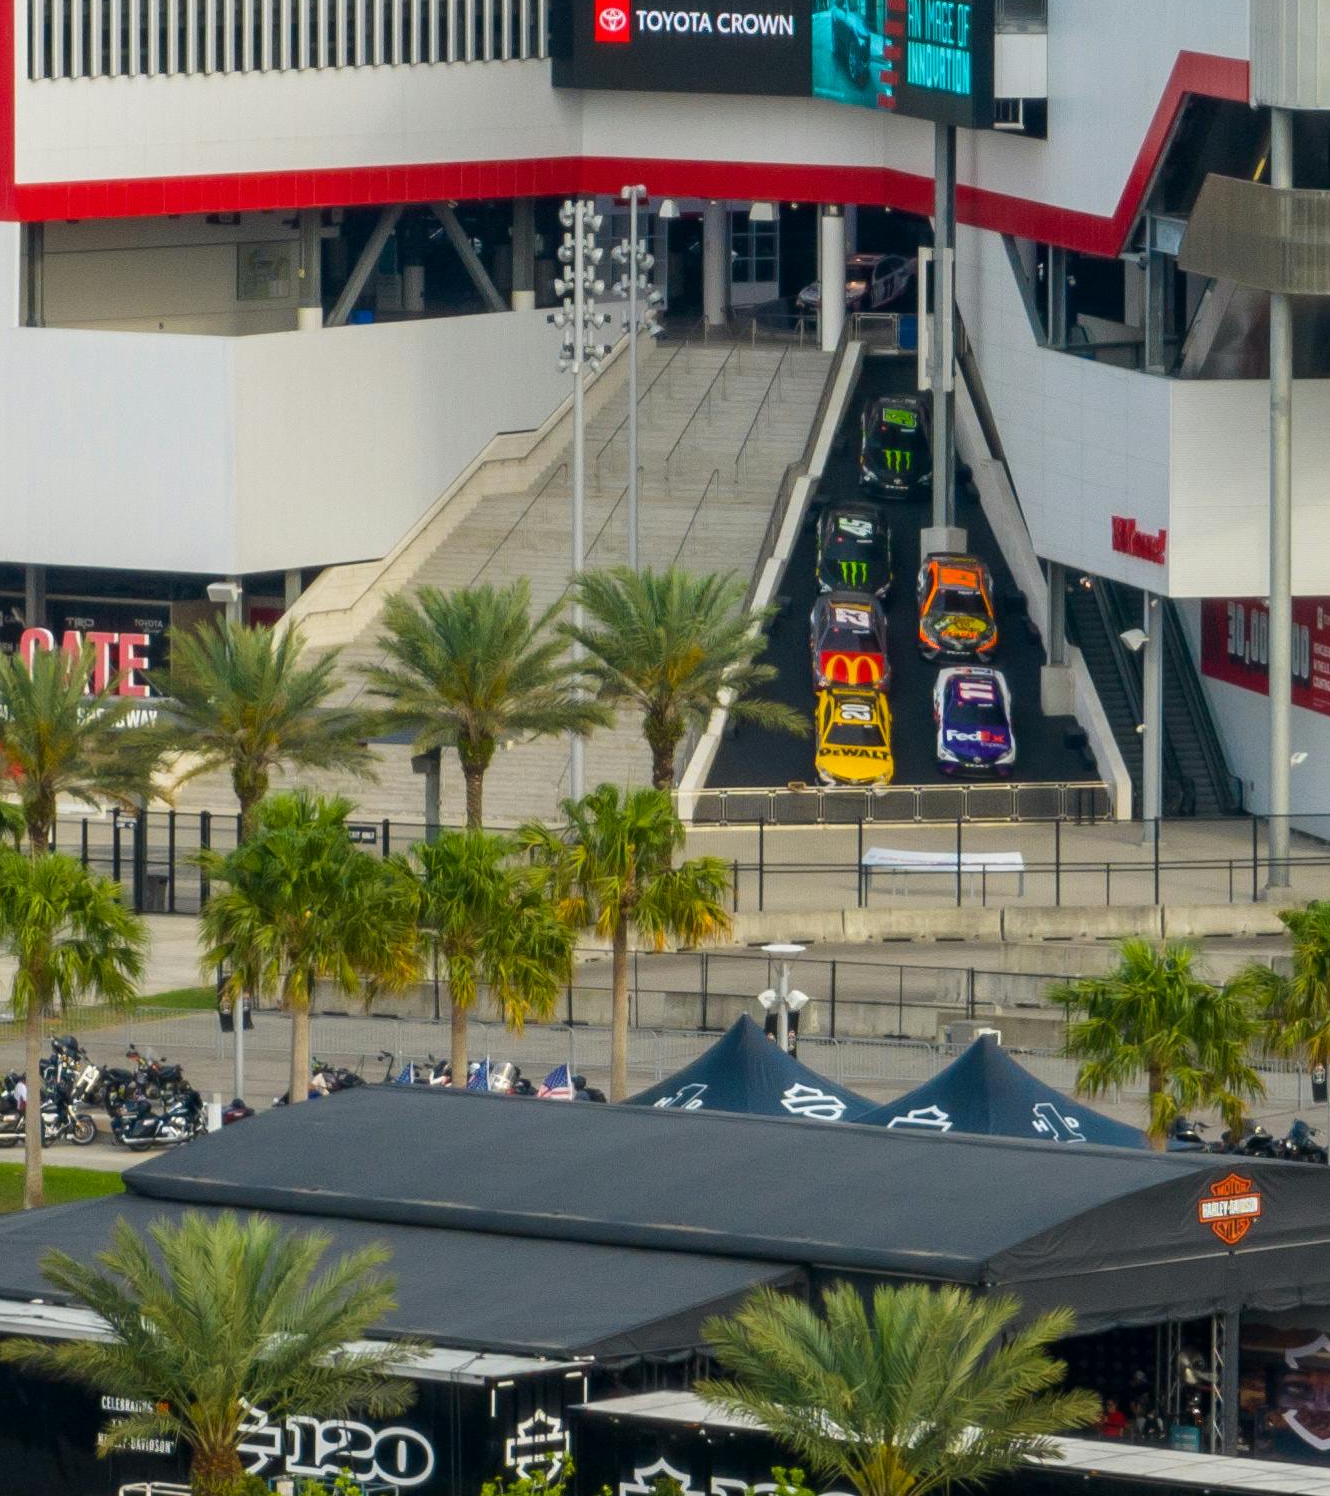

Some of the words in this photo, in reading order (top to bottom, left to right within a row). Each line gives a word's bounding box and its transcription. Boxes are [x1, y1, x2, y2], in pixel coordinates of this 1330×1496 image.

[636, 9, 712, 33] TOYOTA
[717, 13, 794, 36] CROWN
[959, 681, 994, 700] 11
[841, 704, 871, 721] 20
[946, 729, 1006, 744] FedEx
[285, 1414, 436, 1486] 120
